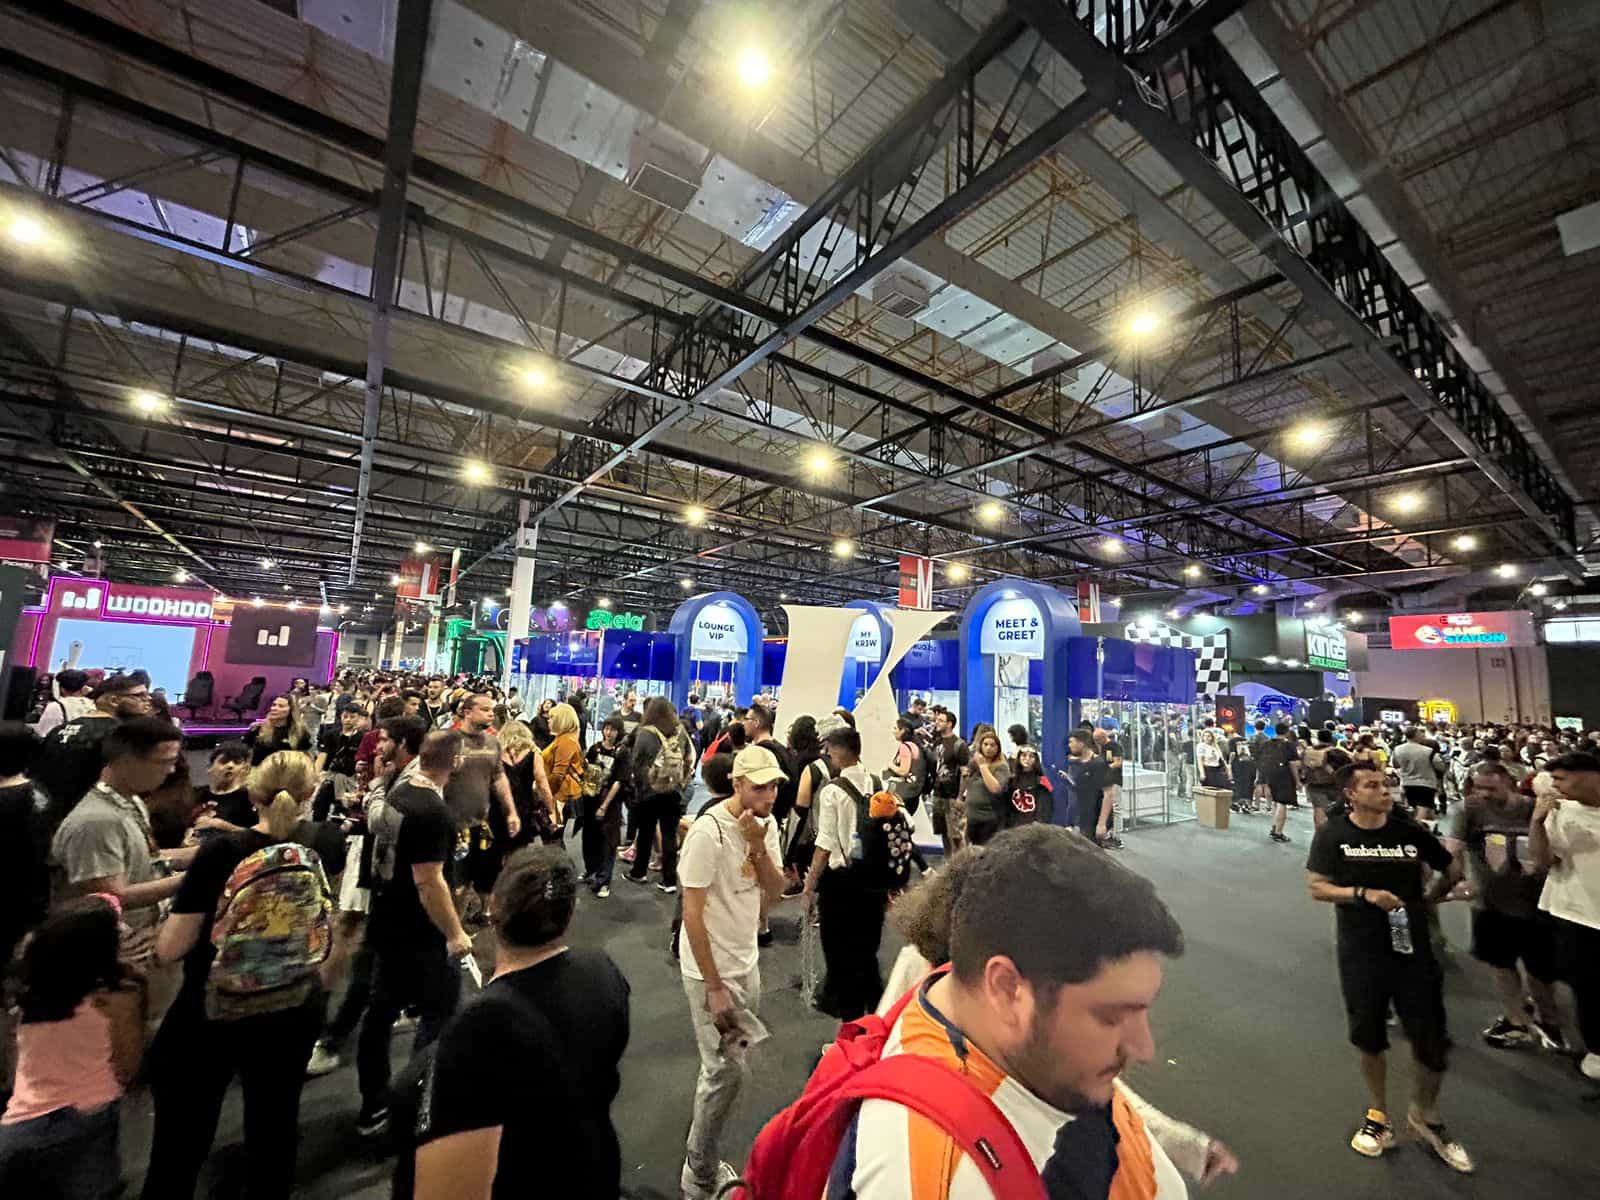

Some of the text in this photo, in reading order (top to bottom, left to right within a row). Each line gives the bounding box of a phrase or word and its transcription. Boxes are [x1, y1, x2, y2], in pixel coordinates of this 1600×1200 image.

[107, 595, 211, 618] WOOHOO
[698, 621, 736, 633] LOUNGE
[995, 617, 1039, 629] MEET &
[708, 632, 725, 640] VIP
[998, 630, 1036, 641] GREET
[1339, 843, 1405, 858] Timberland
